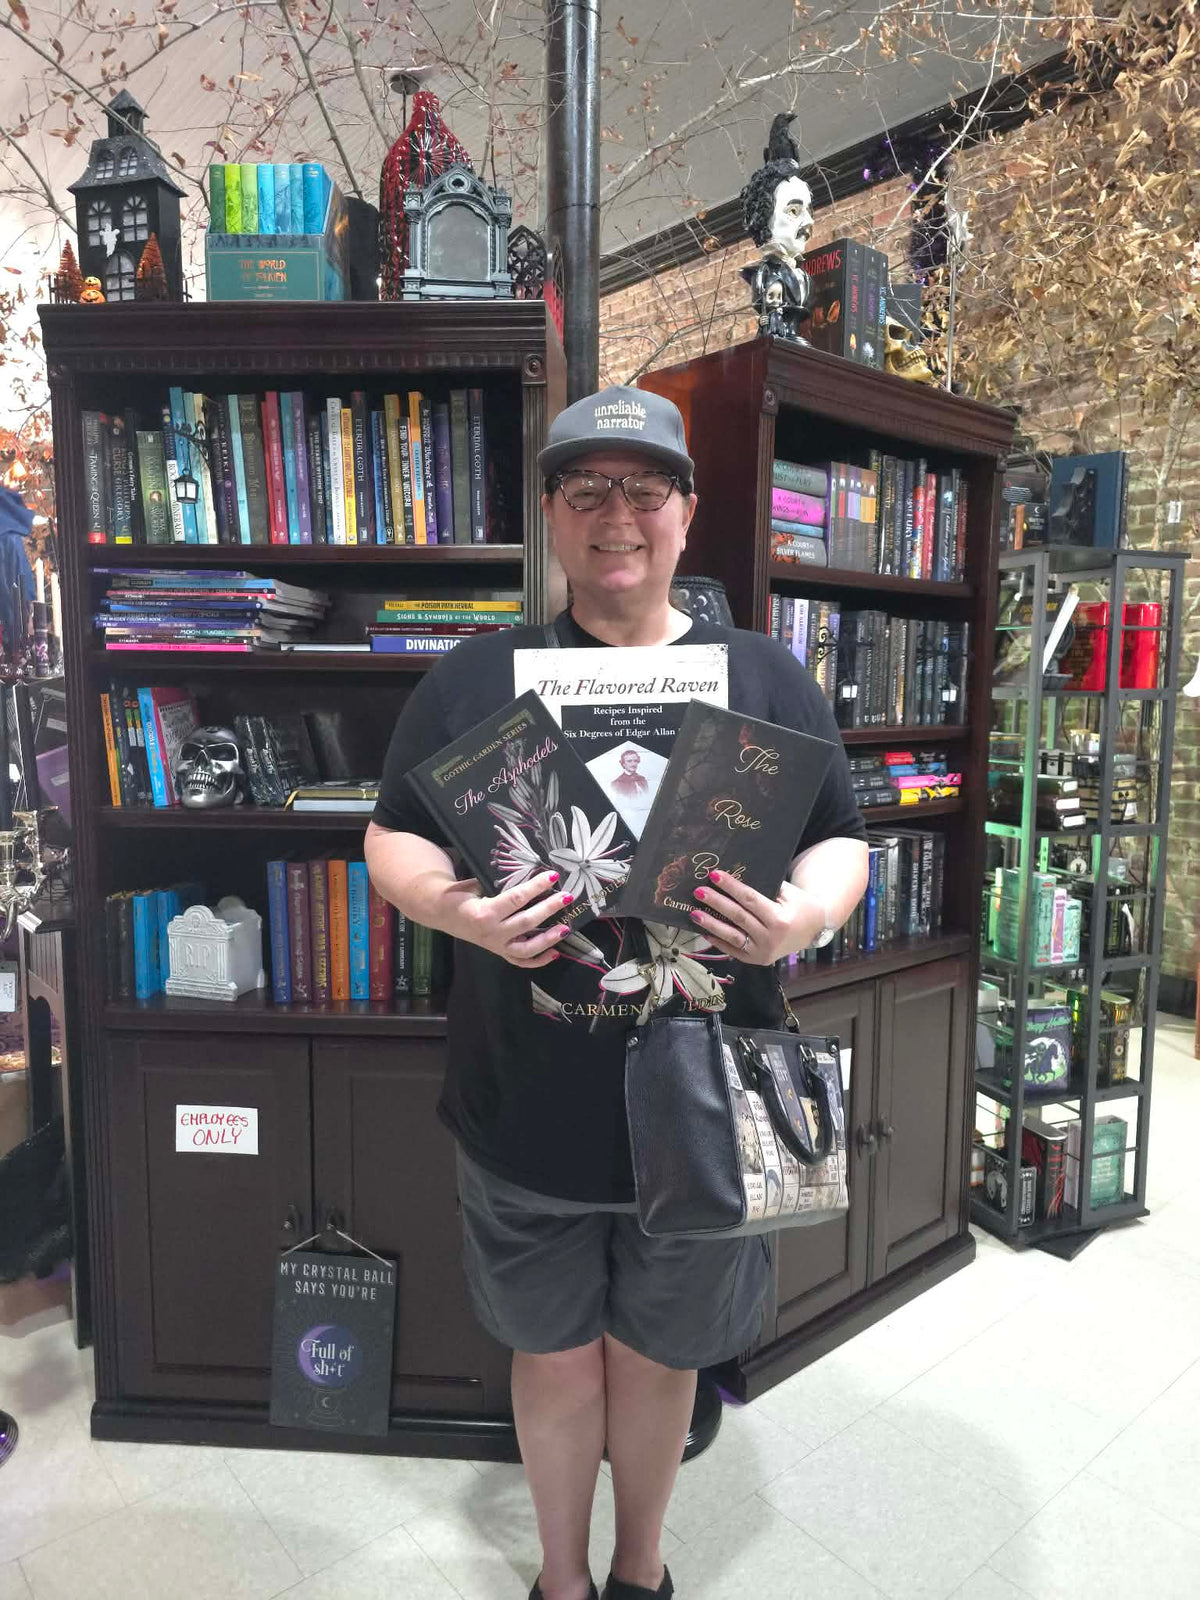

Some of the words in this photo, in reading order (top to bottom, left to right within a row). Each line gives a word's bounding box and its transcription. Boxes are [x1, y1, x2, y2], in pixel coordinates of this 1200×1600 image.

[594, 399, 647, 418] unreliable
[399, 425, 408, 440] FIND
[597, 415, 645, 430] narrator
[354, 418, 363, 455] ETERNAL
[473, 416, 481, 453] ETERNAL
[221, 442, 229, 472] REIKI
[400, 442, 409, 458] YOUR
[89, 454, 98, 485] TAMING
[356, 457, 365, 481] GOTH
[401, 460, 410, 480] INNER
[474, 454, 482, 480] GOTH
[90, 492, 100, 519] QUEEN
[114, 478, 124, 522] GREGORY
[403, 481, 411, 507] UNICORN
[173, 501, 183, 536] MINERALS
[776, 548, 794, 556] SILVER
[795, 549, 815, 559] FLAMES
[793, 541, 810, 549] COURT
[406, 639, 461, 651] DIVINATIO
[538, 679, 570, 696] The
[573, 678, 657, 696] Flavored
[660, 677, 719, 693] Raven
[593, 707, 625, 716] Recipes
[628, 705, 663, 715] Inspired
[610, 717, 631, 726] from
[633, 717, 646, 725] the
[564, 729, 578, 738] Six
[580, 729, 613, 739] Degrees
[615, 728, 625, 737] of
[625, 728, 651, 738] Edgar
[653, 727, 676, 736] Allan
[443, 759, 473, 782] GOTHIC
[472, 740, 503, 763] GARDEN
[501, 721, 528, 744] SERIES
[734, 745, 780, 775] The
[454, 787, 486, 816] The
[487, 736, 559, 793] Asphodels
[714, 799, 761, 829] Rose
[557, 898, 592, 926] ARMEN
[561, 1002, 644, 1017] CARMEN
[180, 1112, 249, 1127] EMPLOYEES
[192, 1127, 243, 1146] ONLY
[281, 1262, 297, 1276] MY
[303, 1263, 358, 1281] CRYSTAL
[364, 1269, 394, 1285] BALL
[295, 1280, 325, 1295] SAYS
[331, 1284, 377, 1300] YOU'RE
[301, 1338, 336, 1360] Full
[339, 1345, 355, 1362] of
